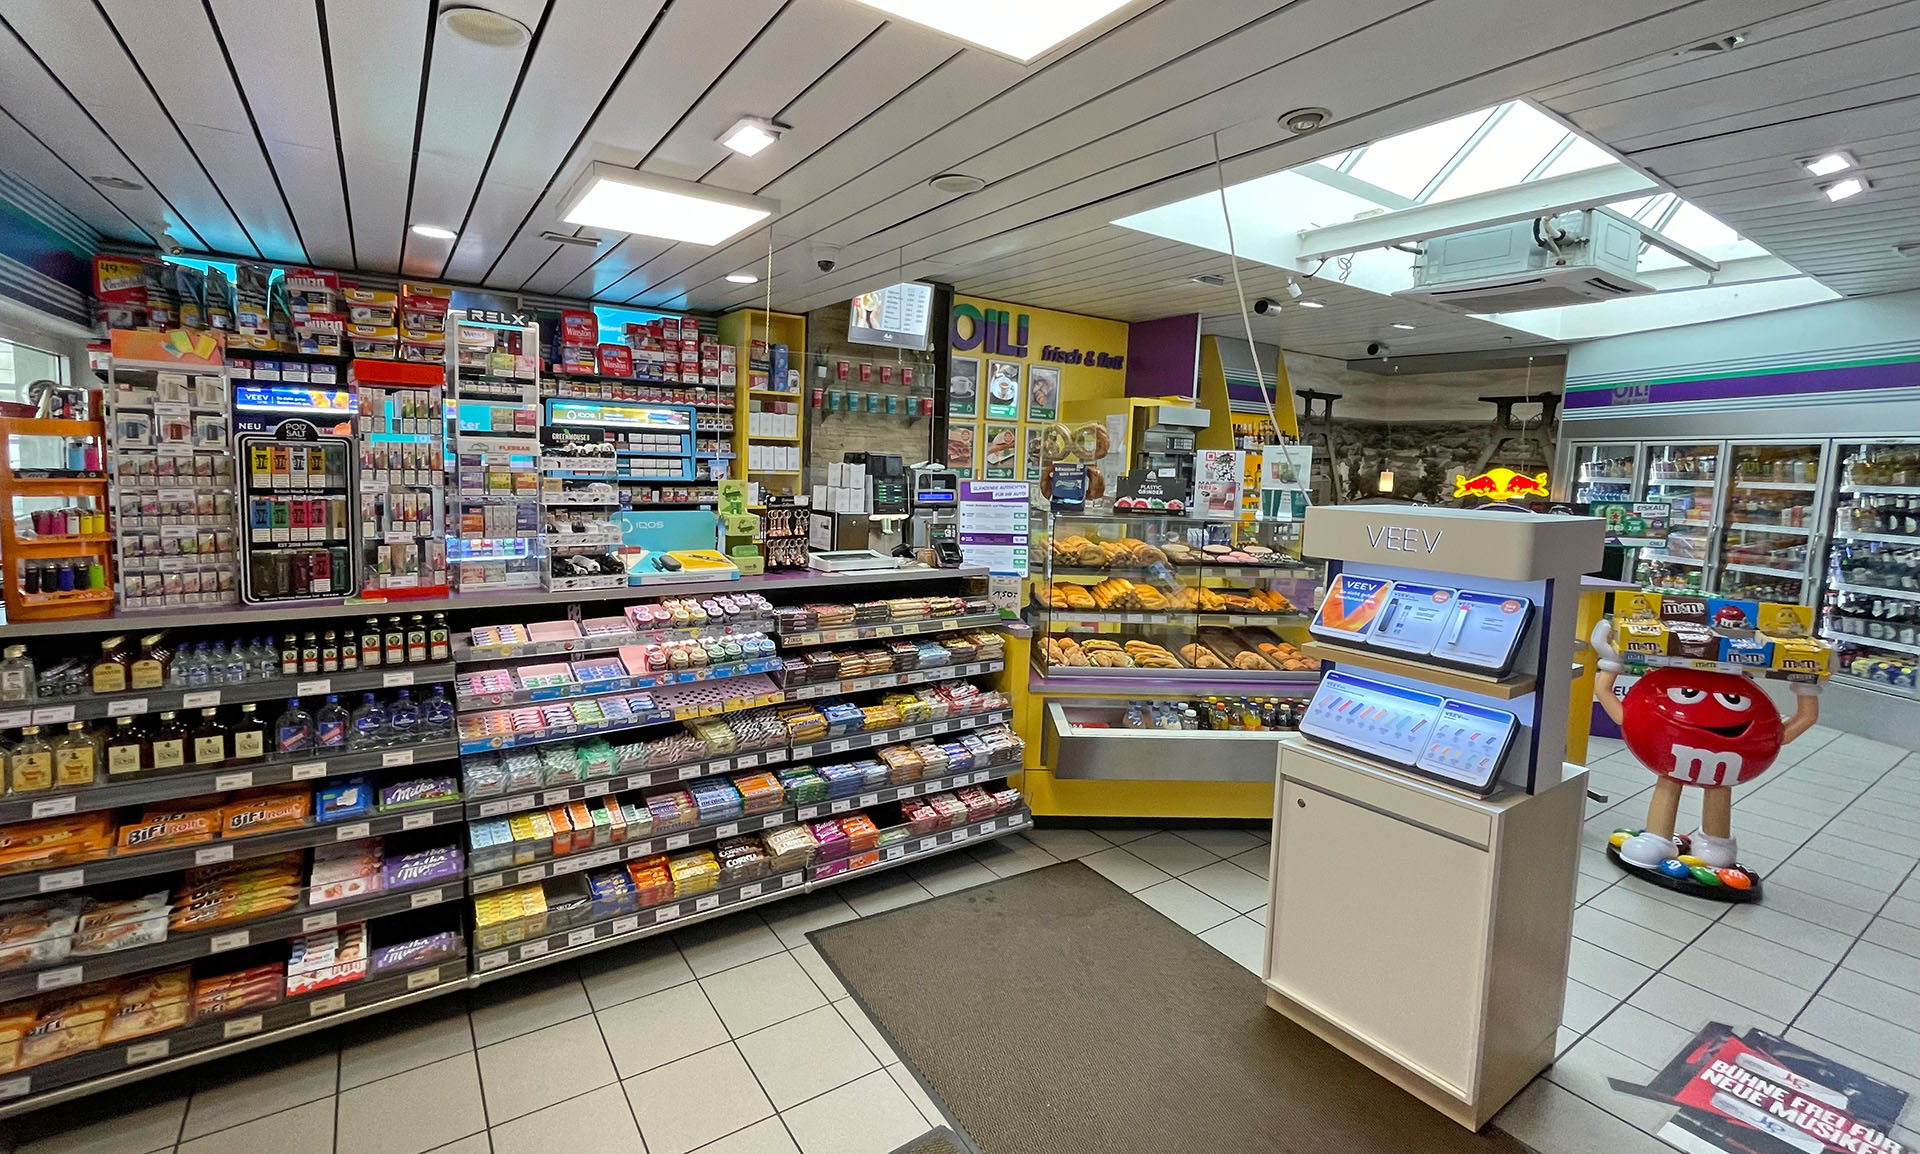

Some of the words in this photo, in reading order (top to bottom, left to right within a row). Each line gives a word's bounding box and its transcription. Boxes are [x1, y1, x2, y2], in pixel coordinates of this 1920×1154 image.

[471, 310, 525, 325] RELX
[566, 327, 591, 338] Winston
[951, 304, 1029, 358] OIL!
[603, 359, 627, 371] Winston
[1041, 345, 1083, 364] frisch
[1084, 351, 1096, 366] &
[636, 521, 664, 529] IQOS
[1366, 525, 1443, 554] VEEV
[1347, 581, 1377, 591] VEEV
[1667, 744, 1743, 786] m
[392, 782, 436, 801] Milka
[231, 810, 267, 828] BiFi
[128, 824, 167, 847] BiFi
[1700, 1068, 1768, 1107] NEUE
[1769, 1103, 1893, 1154] MUSIKE
[1710, 1059, 1790, 1101] BÜHNE
[1790, 1095, 1851, 1128] FREI
[1849, 1122, 1904, 1154] FÜR
